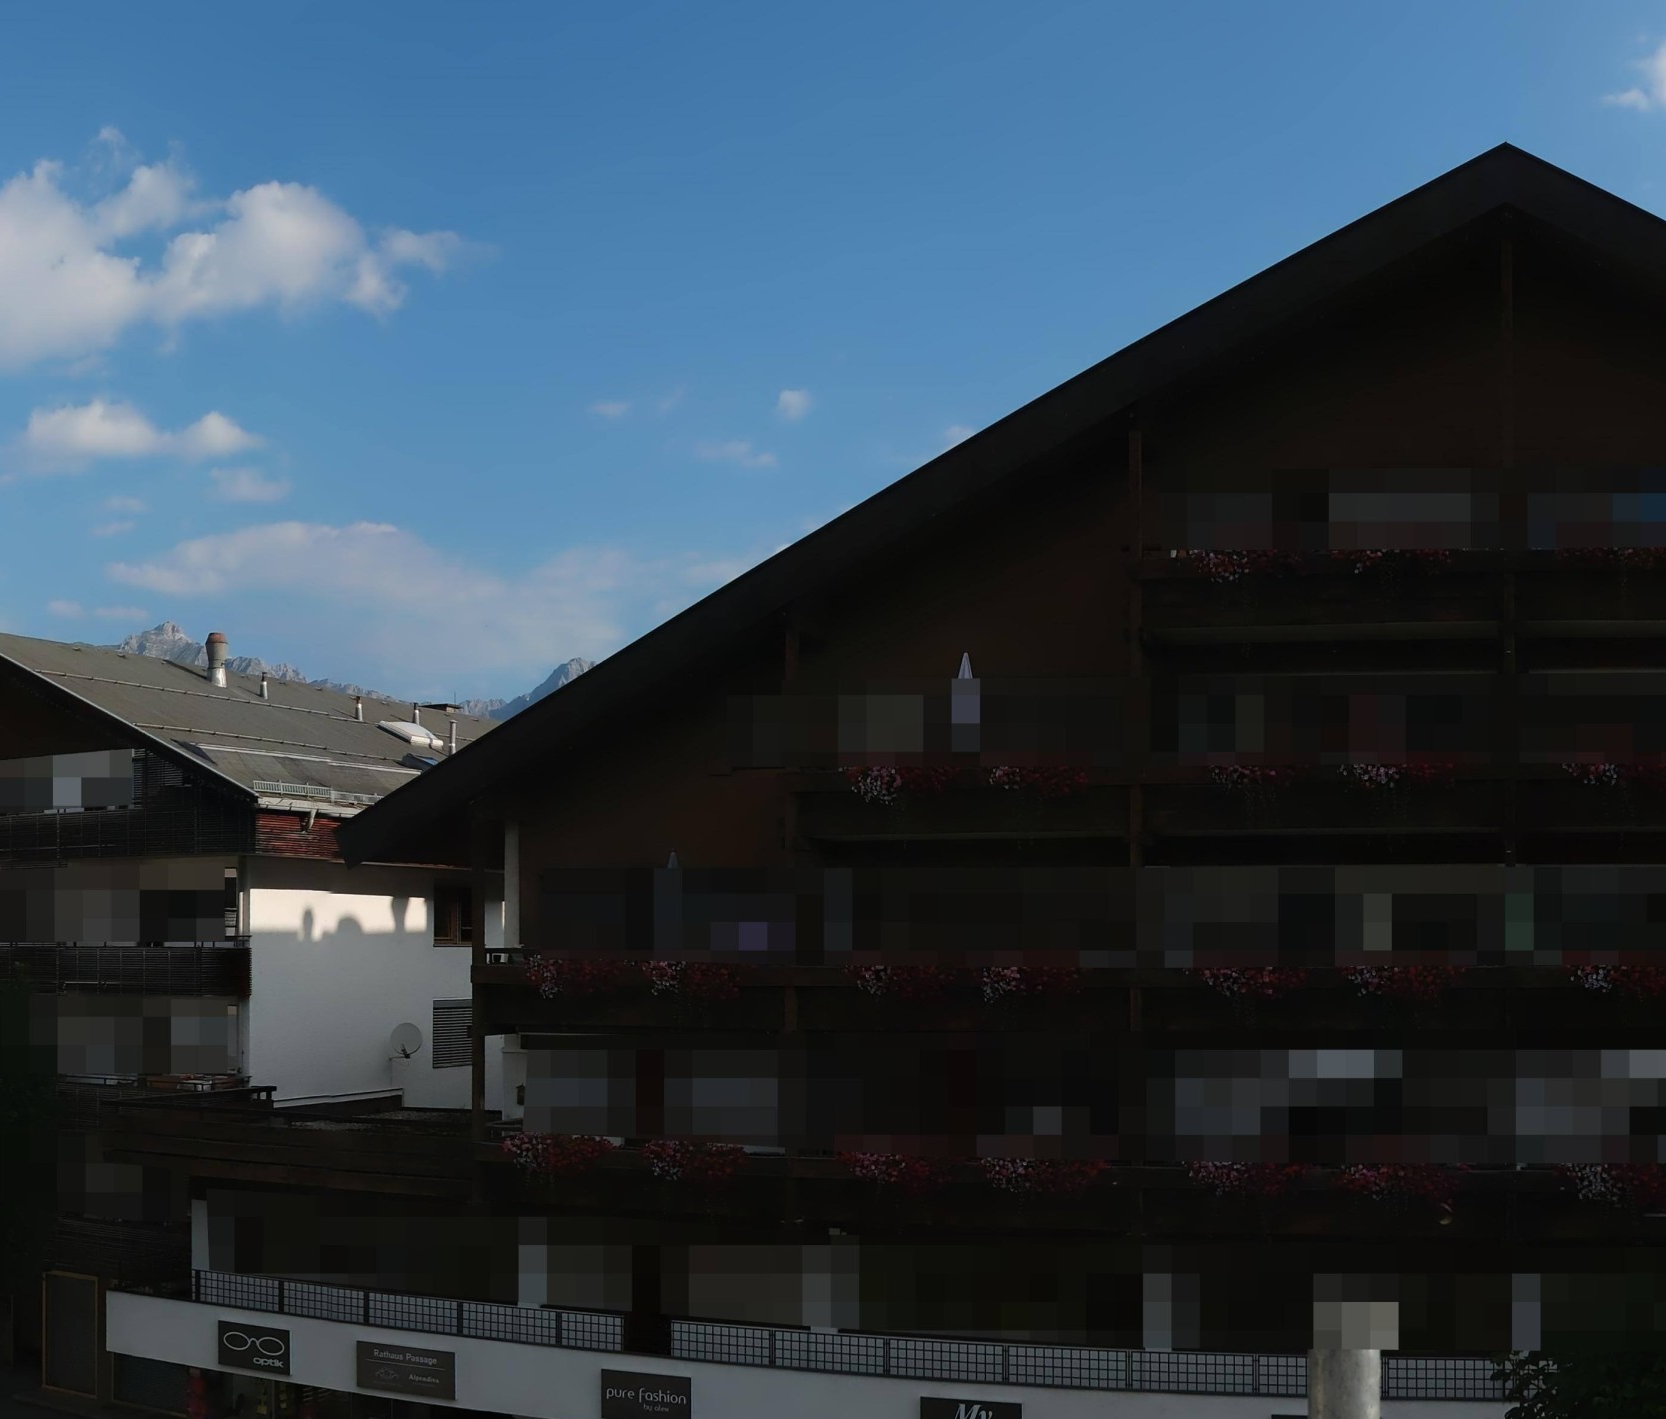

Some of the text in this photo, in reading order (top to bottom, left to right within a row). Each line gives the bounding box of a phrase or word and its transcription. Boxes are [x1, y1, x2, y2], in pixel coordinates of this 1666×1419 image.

[253, 1357, 284, 1368] optik
[374, 1349, 437, 1366] Rathaus Passage
[606, 1387, 686, 1405] pure fashion
[643, 1404, 653, 1412] by
